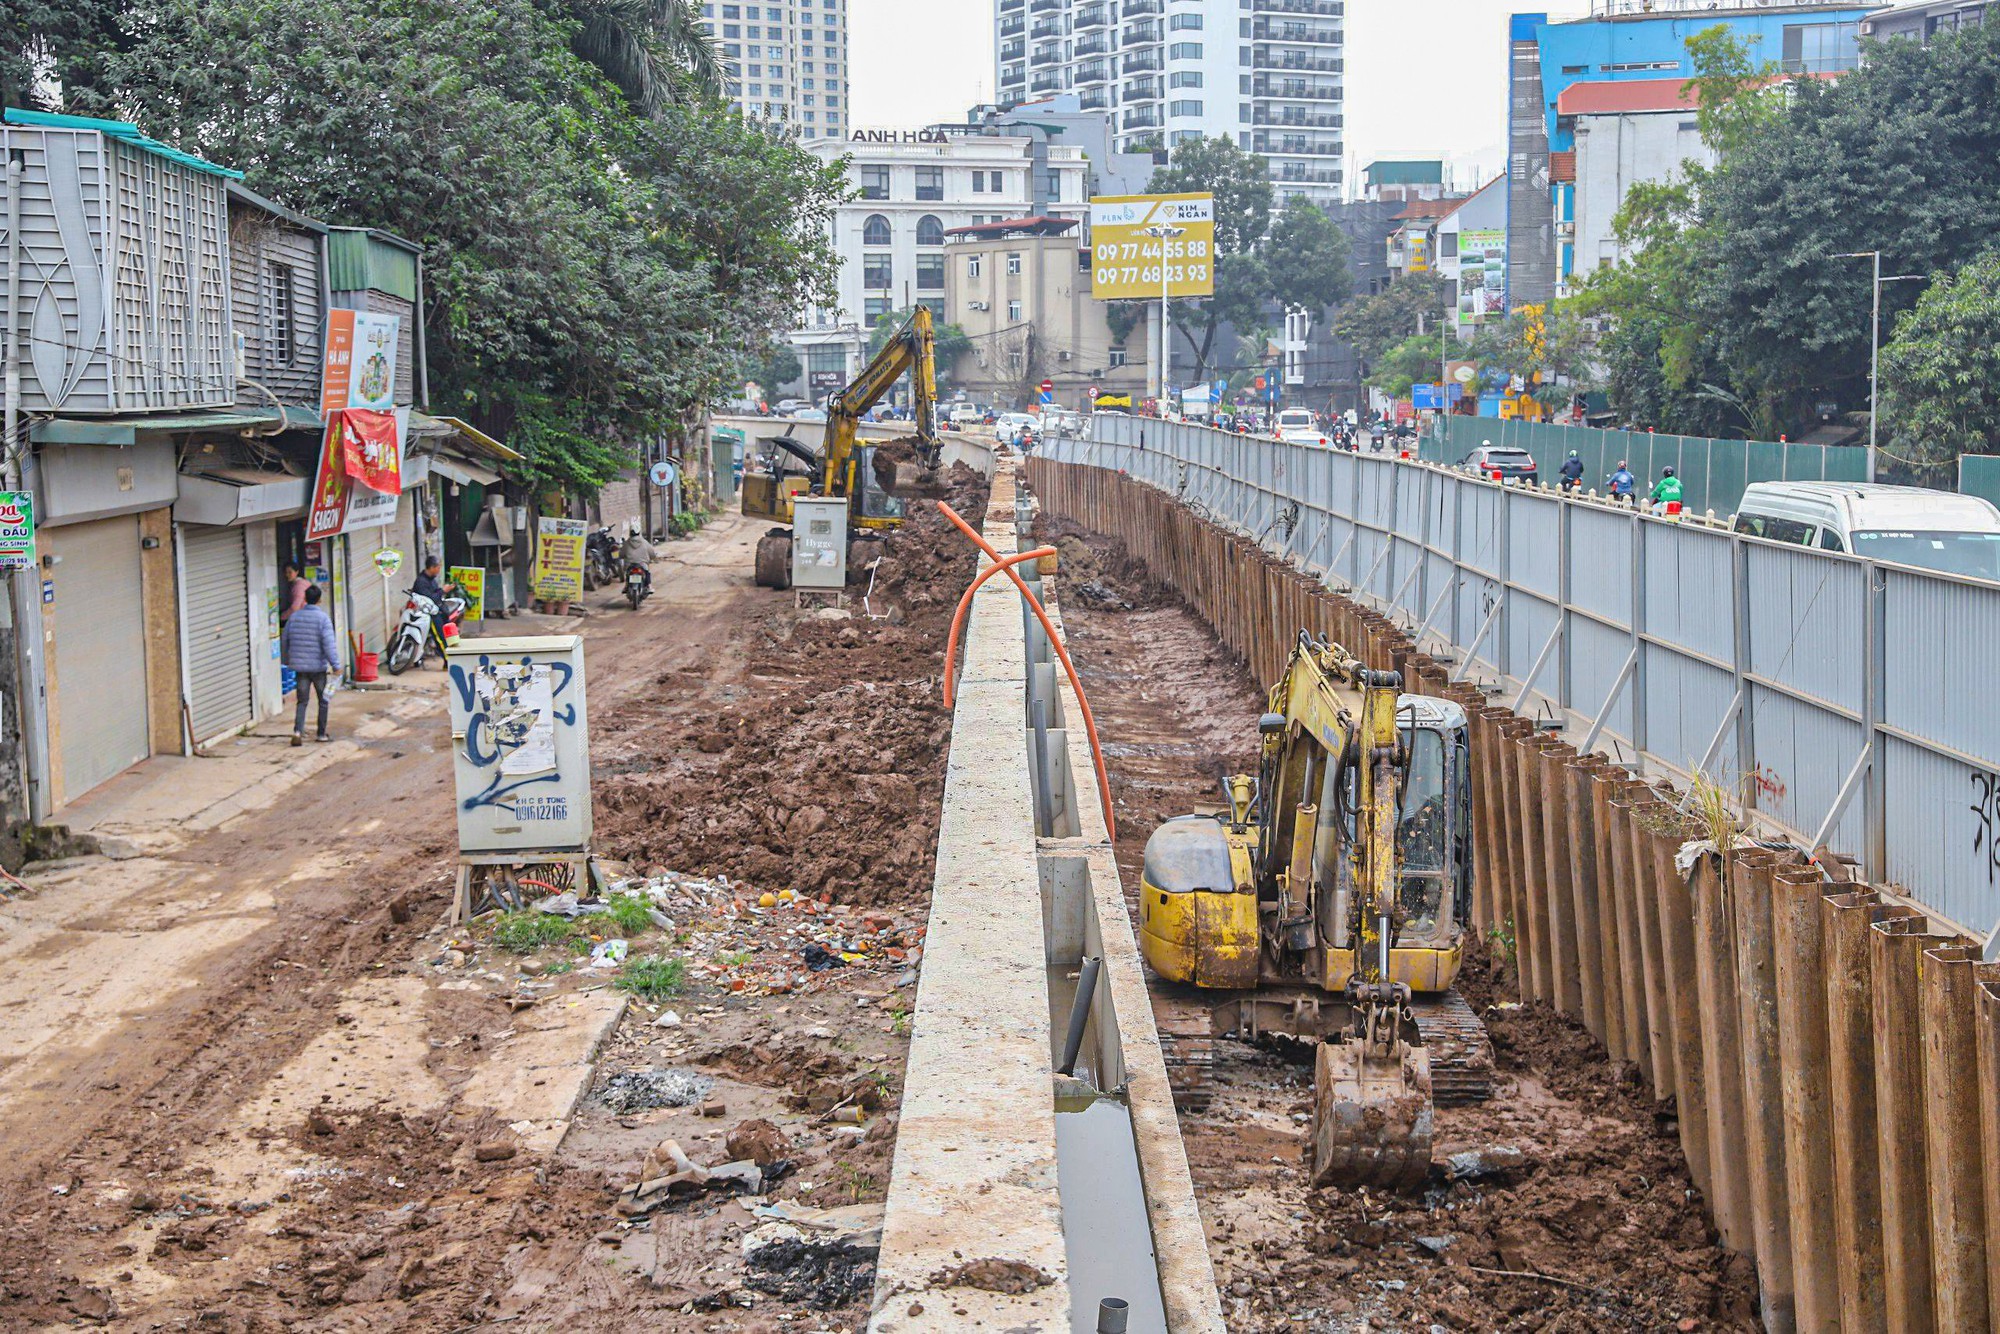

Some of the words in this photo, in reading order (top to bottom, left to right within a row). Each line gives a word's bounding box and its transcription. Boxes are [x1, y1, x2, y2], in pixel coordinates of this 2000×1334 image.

[852, 129, 897, 142] ANH
[1178, 204, 1197, 212] KIM
[1097, 244, 1117, 260] 09
[1121, 243, 1138, 259] 77
[1141, 242, 1162, 258] 44
[1166, 241, 1184, 258] 55
[1187, 240, 1206, 258] 88
[1097, 267, 1117, 284] 09
[1121, 267, 1138, 283] 77
[1142, 266, 1161, 282] 68
[1166, 265, 1183, 282] 23
[1187, 264, 1207, 281] 93
[515, 805, 568, 820] 0916122166
